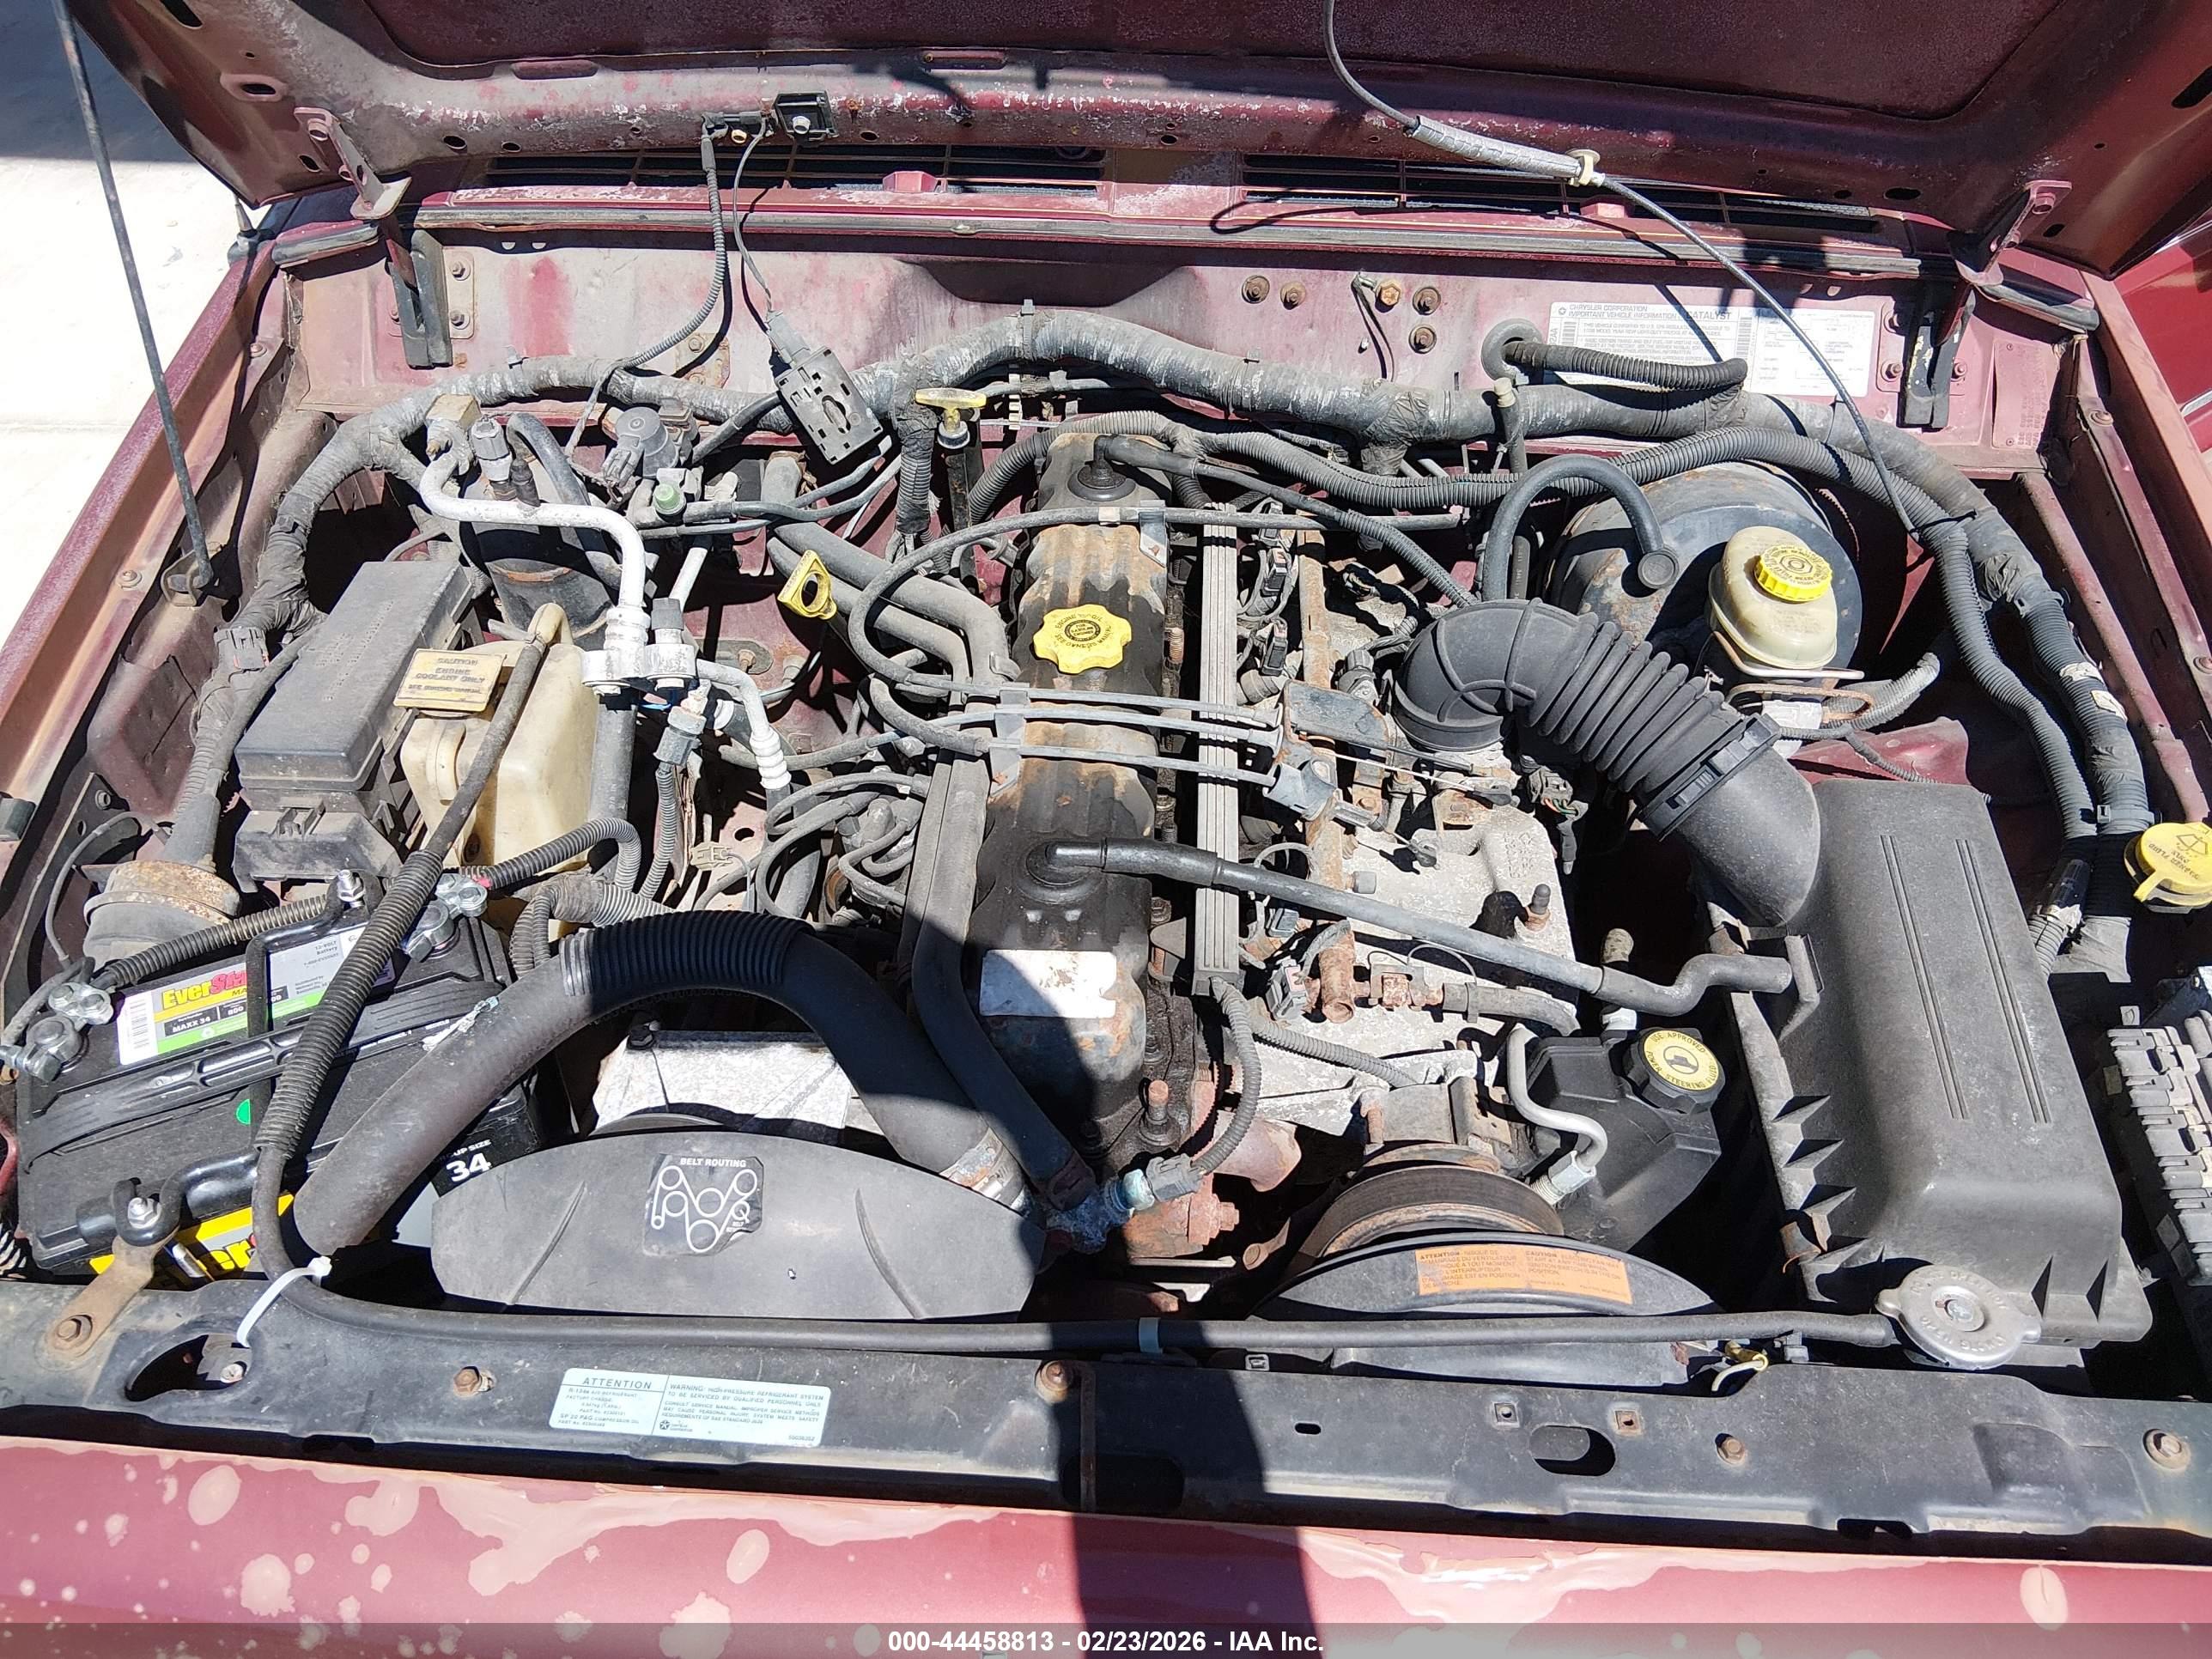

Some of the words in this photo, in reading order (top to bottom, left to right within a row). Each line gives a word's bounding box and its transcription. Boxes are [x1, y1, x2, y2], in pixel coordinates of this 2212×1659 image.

[1091, 614, 1103, 623] OIL
[416, 672, 459, 681] COOLANT
[161, 970, 247, 1011] EverSta
[172, 1019, 198, 1033] MAXX
[199, 1016, 211, 1024] 34
[1650, 1031, 1664, 1042] USE
[1667, 1031, 1706, 1053] APPROVED
[1645, 1050, 1663, 1073] POWER
[1666, 1073, 1706, 1089] STEERING
[468, 1139, 492, 1152] SIZE
[446, 1152, 493, 1182] 34
[680, 1158, 703, 1166] BELT
[704, 1158, 747, 1168] ROUTING
[1420, 1251, 1461, 1261] ATTENTION
[582, 1376, 653, 1390] ATTENTION
[670, 1383, 704, 1392] WARNING:
[708, 1386, 756, 1396] HIGH-PRESSURE
[757, 1390, 799, 1400] REFRIGERANT
